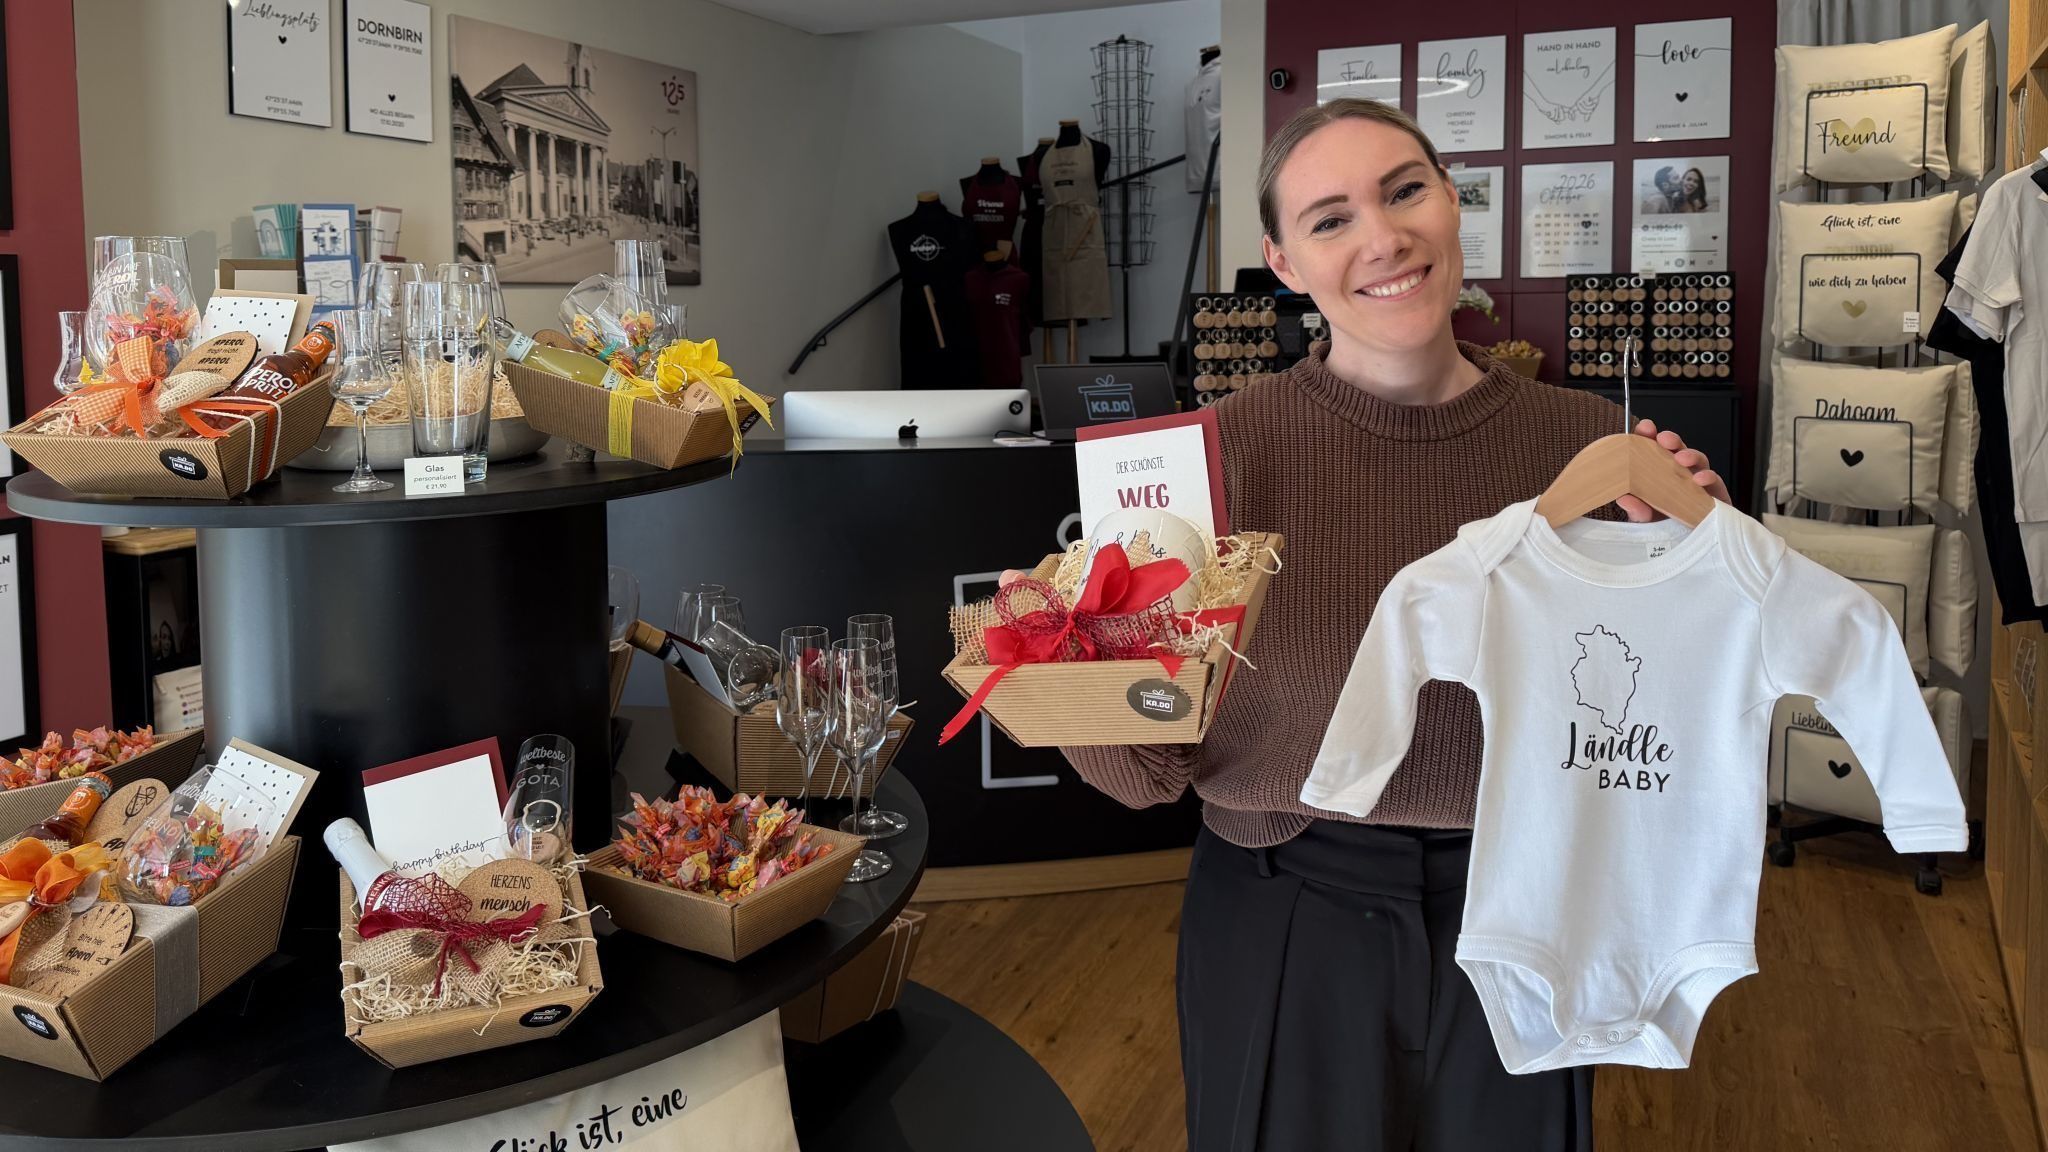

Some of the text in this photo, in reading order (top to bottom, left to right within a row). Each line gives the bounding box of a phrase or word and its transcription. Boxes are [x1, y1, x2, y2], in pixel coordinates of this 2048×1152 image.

[242, 2, 320, 33] Lieblingsplatz
[358, 18, 422, 44] DORNBIRN
[1537, 44, 1561, 52] HAND
[1576, 41, 1601, 49] HAND
[1660, 40, 1703, 65] love
[1437, 48, 1487, 99] family
[1815, 118, 1897, 154] Freund
[1553, 172, 1596, 190] 2026
[1820, 215, 1855, 232] Glück
[1878, 216, 1902, 226] eine
[1808, 274, 1907, 289] wie dich zu haben
[1091, 401, 1130, 414] KA.DO
[424, 465, 445, 473] Glas
[1116, 456, 1165, 474] DER SCHÖNSTE
[413, 473, 457, 482] personalisiert
[1117, 483, 1170, 509] WEG
[1146, 699, 1170, 710] KA.DO
[520, 746, 566, 763] weltbeste
[1561, 722, 1673, 770] Ländle
[516, 774, 560, 788] GOTA
[1599, 769, 1671, 793] BABY
[391, 836, 499, 873] happy birthday
[490, 874, 533, 890] HERZENS
[480, 895, 531, 912] mensch
[78, 934, 104, 946] Bitte hier
[66, 946, 95, 962] Aperol
[576, 1104, 623, 1150] ist,
[631, 1088, 688, 1127] eine
